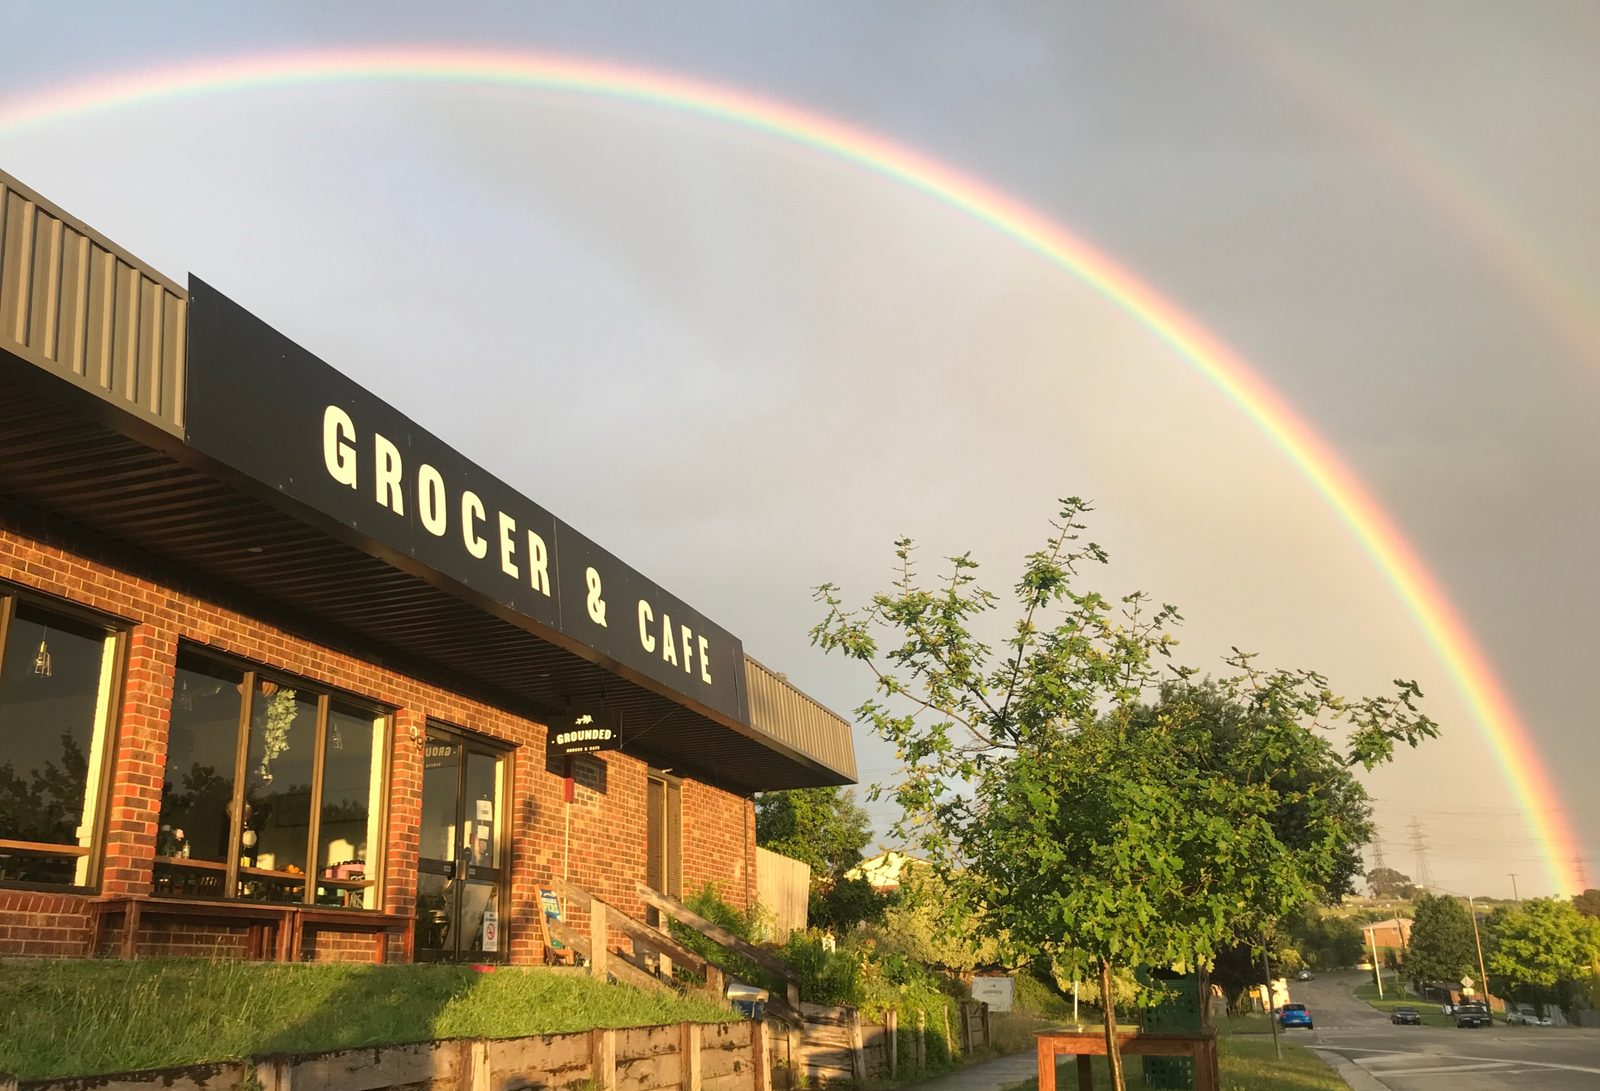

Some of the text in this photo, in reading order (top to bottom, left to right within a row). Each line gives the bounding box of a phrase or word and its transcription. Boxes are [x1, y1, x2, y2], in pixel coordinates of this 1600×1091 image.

[323, 405, 712, 685] GROCER & CAFE
[556, 729, 612, 745] GROUNDED
